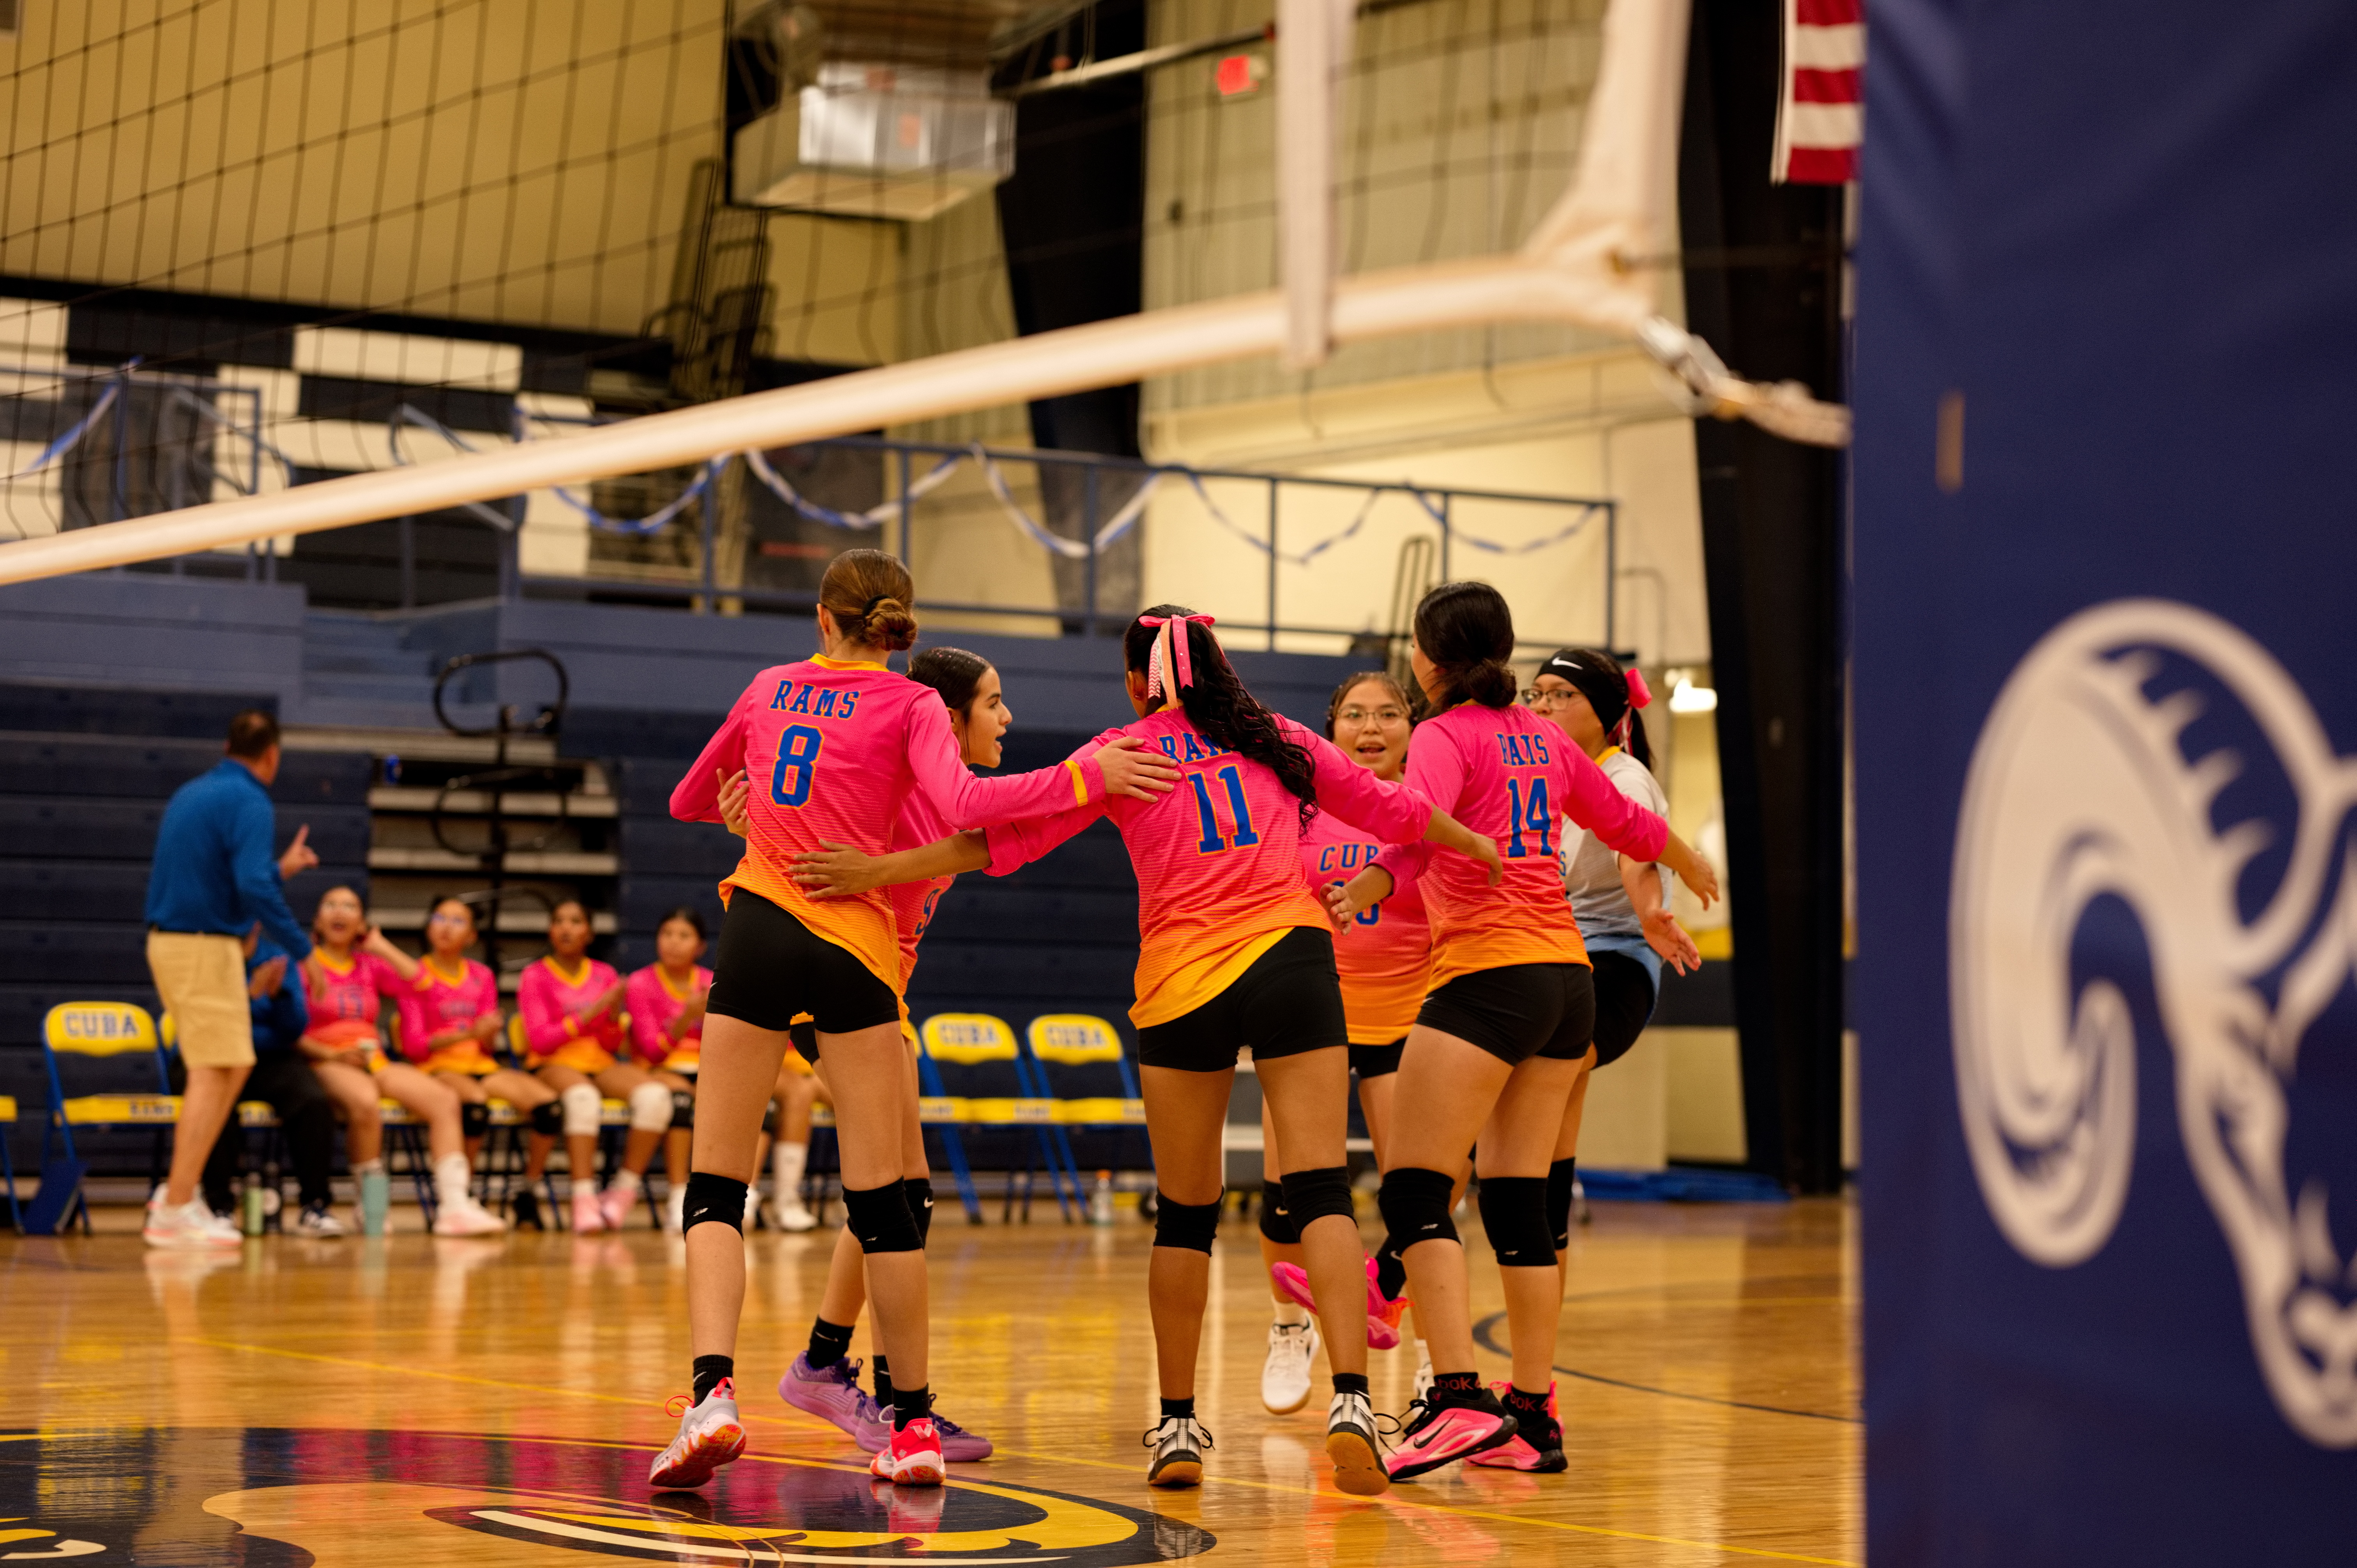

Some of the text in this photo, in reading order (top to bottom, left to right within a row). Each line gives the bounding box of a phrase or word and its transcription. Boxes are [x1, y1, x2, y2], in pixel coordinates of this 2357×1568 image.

[769, 679, 861, 720] RAMS
[1159, 732, 1234, 765] RAM
[769, 722, 825, 809] 8
[1186, 764, 1261, 855] 11
[1506, 776, 1554, 860] 14
[1318, 842, 1382, 874] CUB
[65, 1013, 138, 1037] CUBA
[940, 1023, 999, 1044] CUBA
[1048, 1026, 1105, 1047] CUBA
